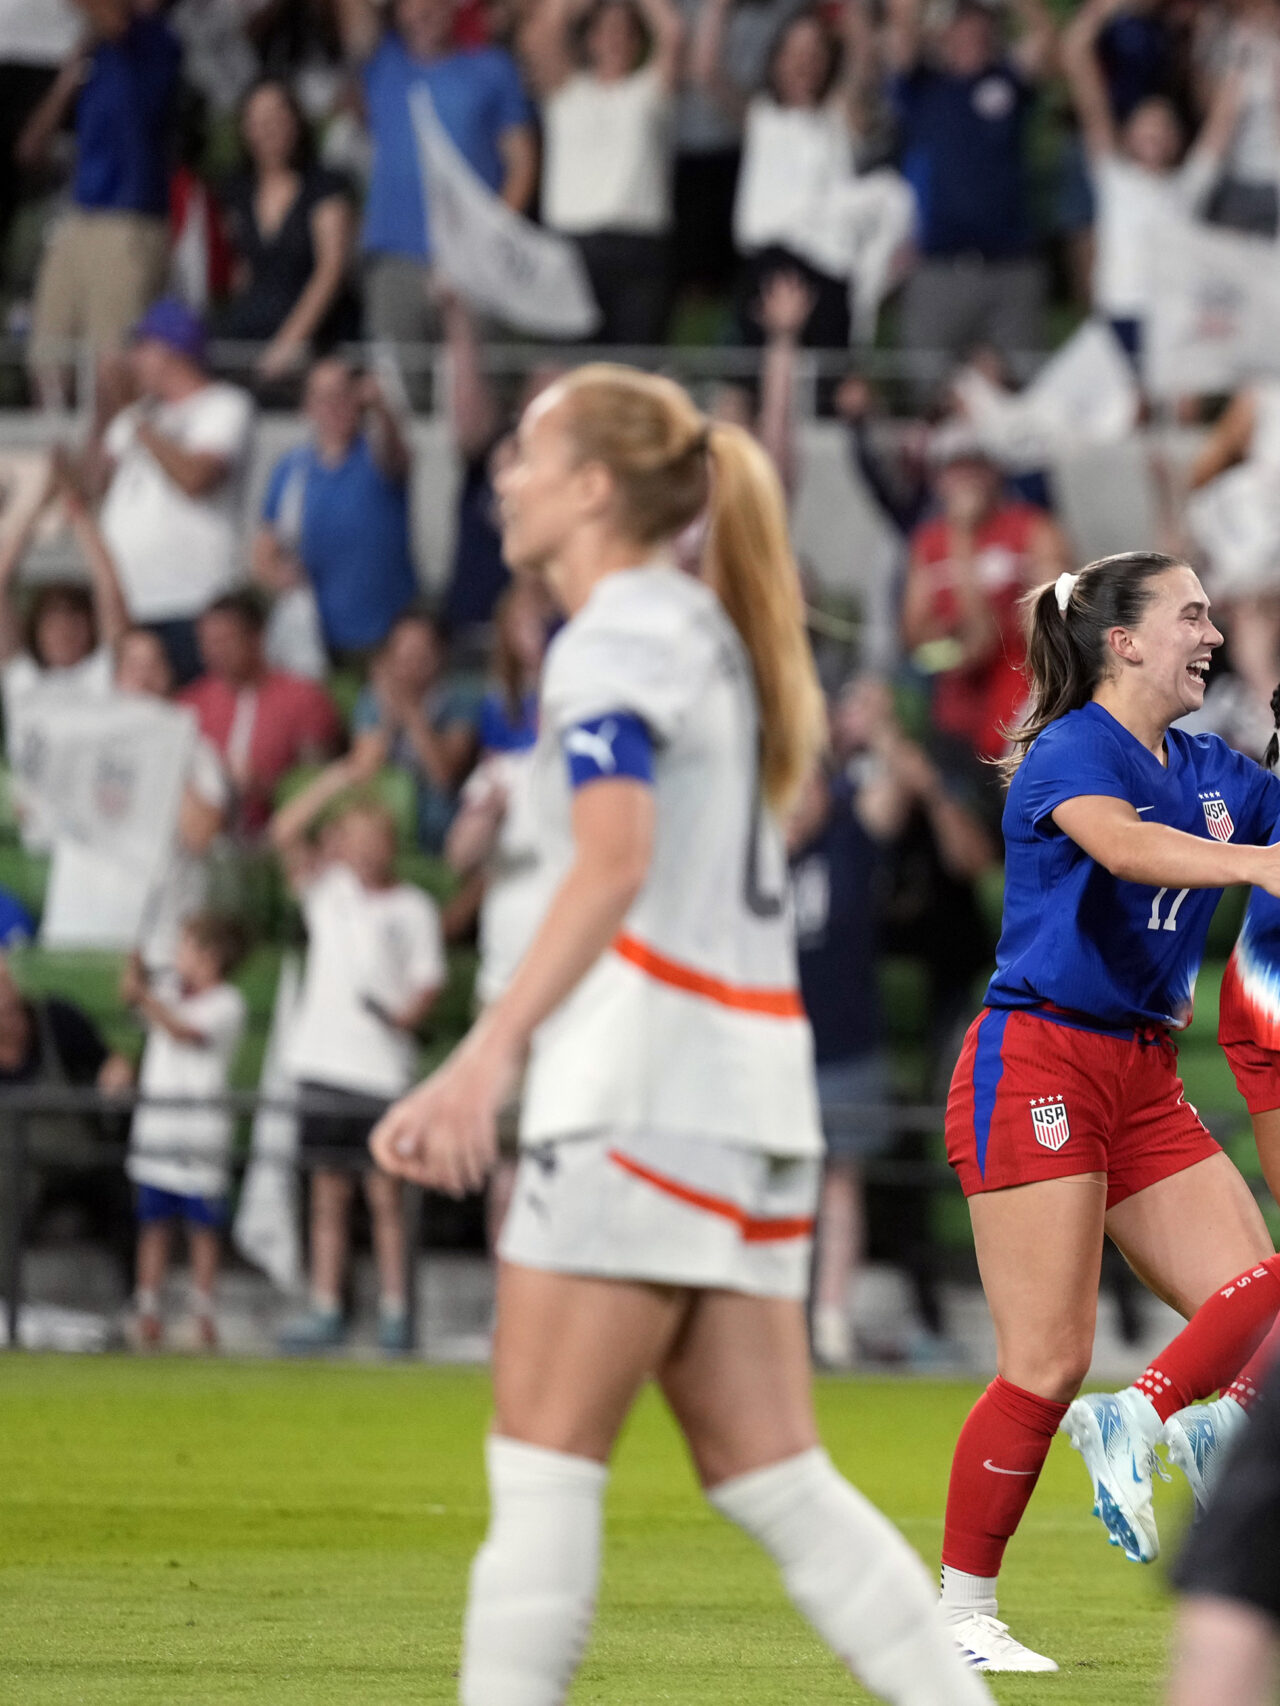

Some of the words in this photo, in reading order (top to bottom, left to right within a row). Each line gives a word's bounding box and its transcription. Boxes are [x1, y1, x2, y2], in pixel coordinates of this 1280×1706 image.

[1205, 802, 1226, 820] USA
[1034, 1106, 1064, 1124] USA
[1220, 1267, 1268, 1299] USA
